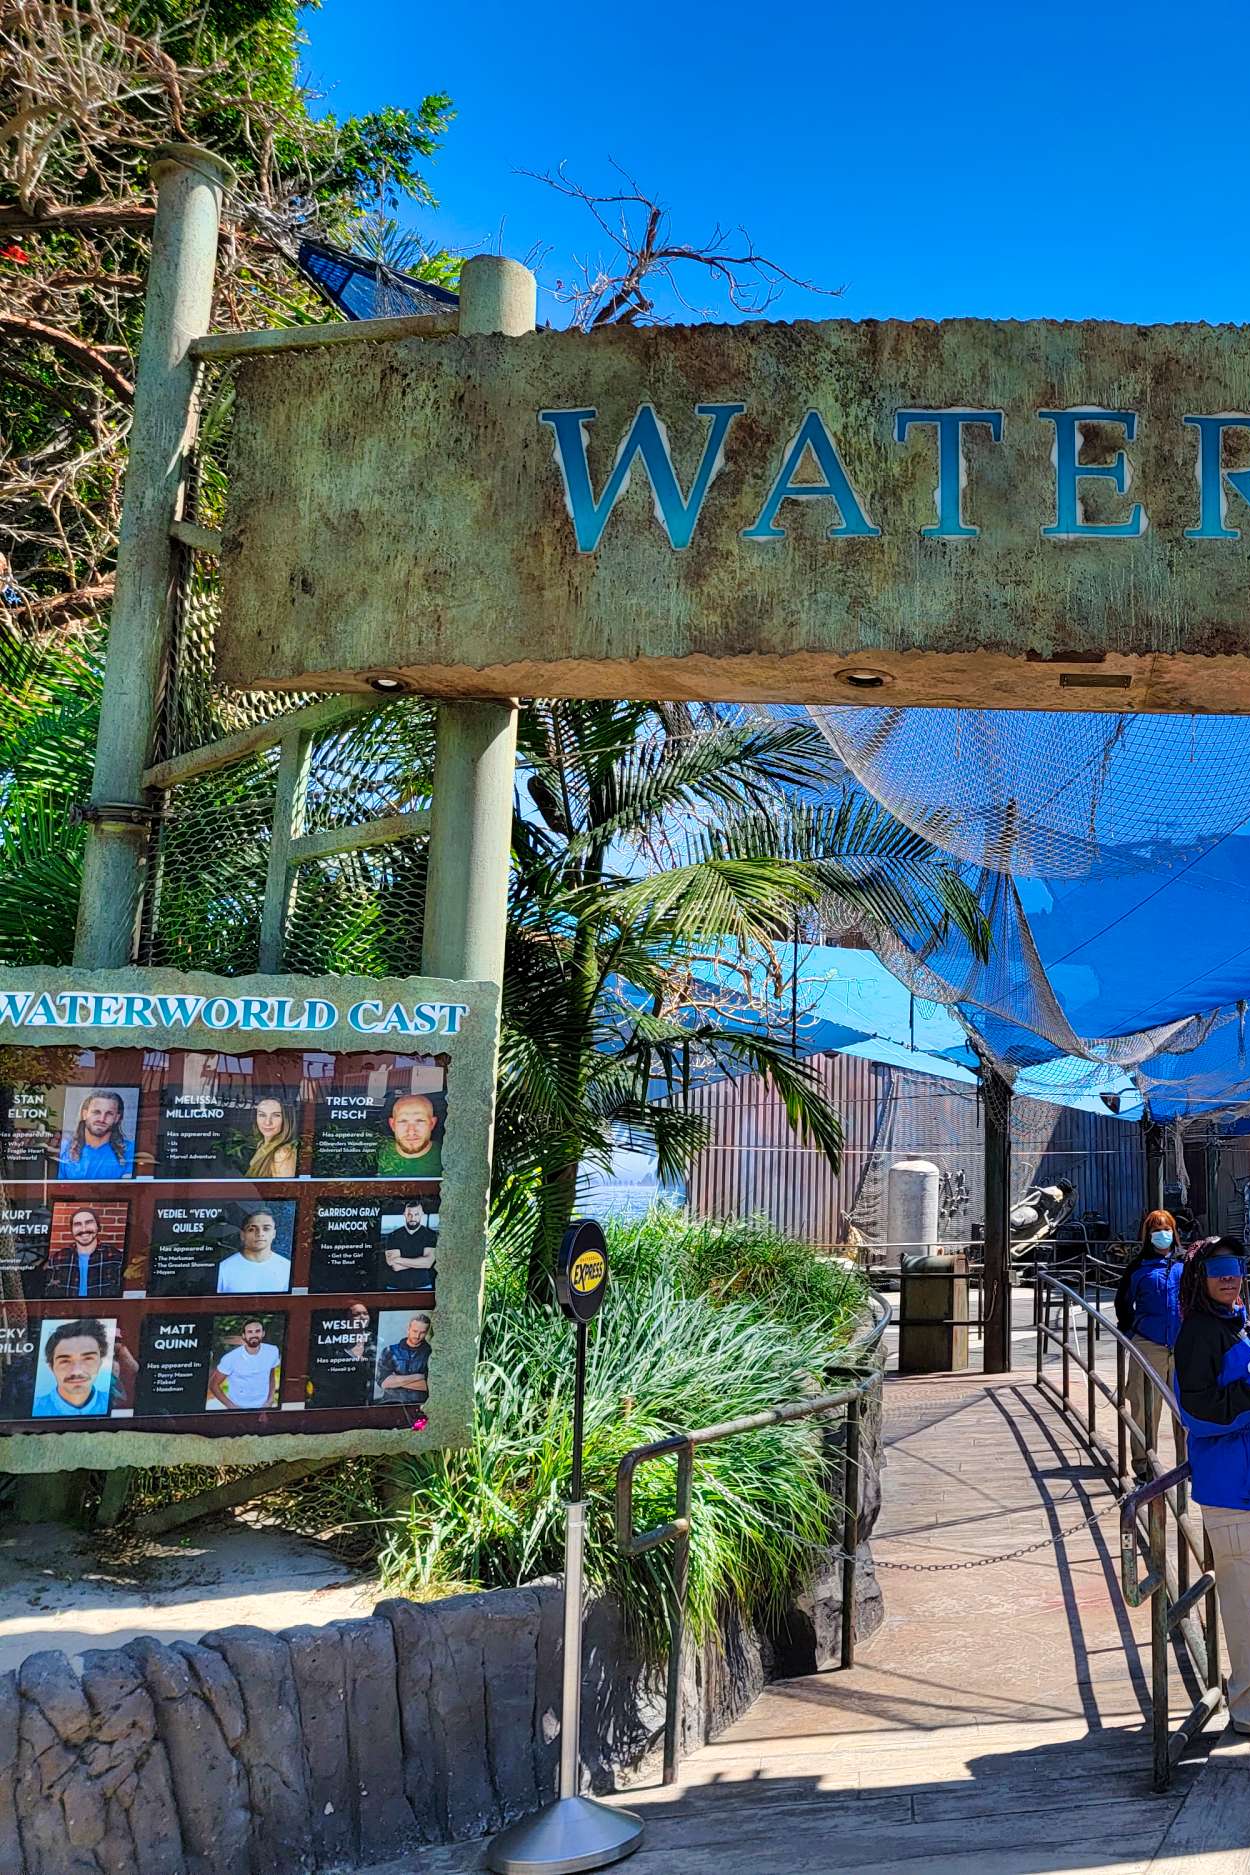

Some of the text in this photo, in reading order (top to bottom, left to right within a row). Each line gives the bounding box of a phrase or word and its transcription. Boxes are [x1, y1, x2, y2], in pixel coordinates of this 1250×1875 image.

[0, 992, 469, 1036] WATERWORLD CAST
[14, 1094, 44, 1104] STAN
[175, 1095, 217, 1105] MELISSA
[326, 1096, 374, 1106] TREVOR
[8, 1109, 48, 1118] ELTON
[166, 1109, 224, 1118] MILLICANO
[331, 1111, 366, 1119] FISCH
[2, 1210, 32, 1220] KURT
[158, 1209, 187, 1218] YEDIEL
[318, 1208, 380, 1217] GARRISON GRAY
[172, 1223, 204, 1233] QUILES
[328, 1221, 368, 1231] HANCOCK
[173, 1245, 204, 1253] appeared
[160, 1324, 196, 1334] MATT
[322, 1320, 368, 1330] WESLEY
[318, 1334, 370, 1344] LAMBERT
[154, 1339, 198, 1350] QUINN
